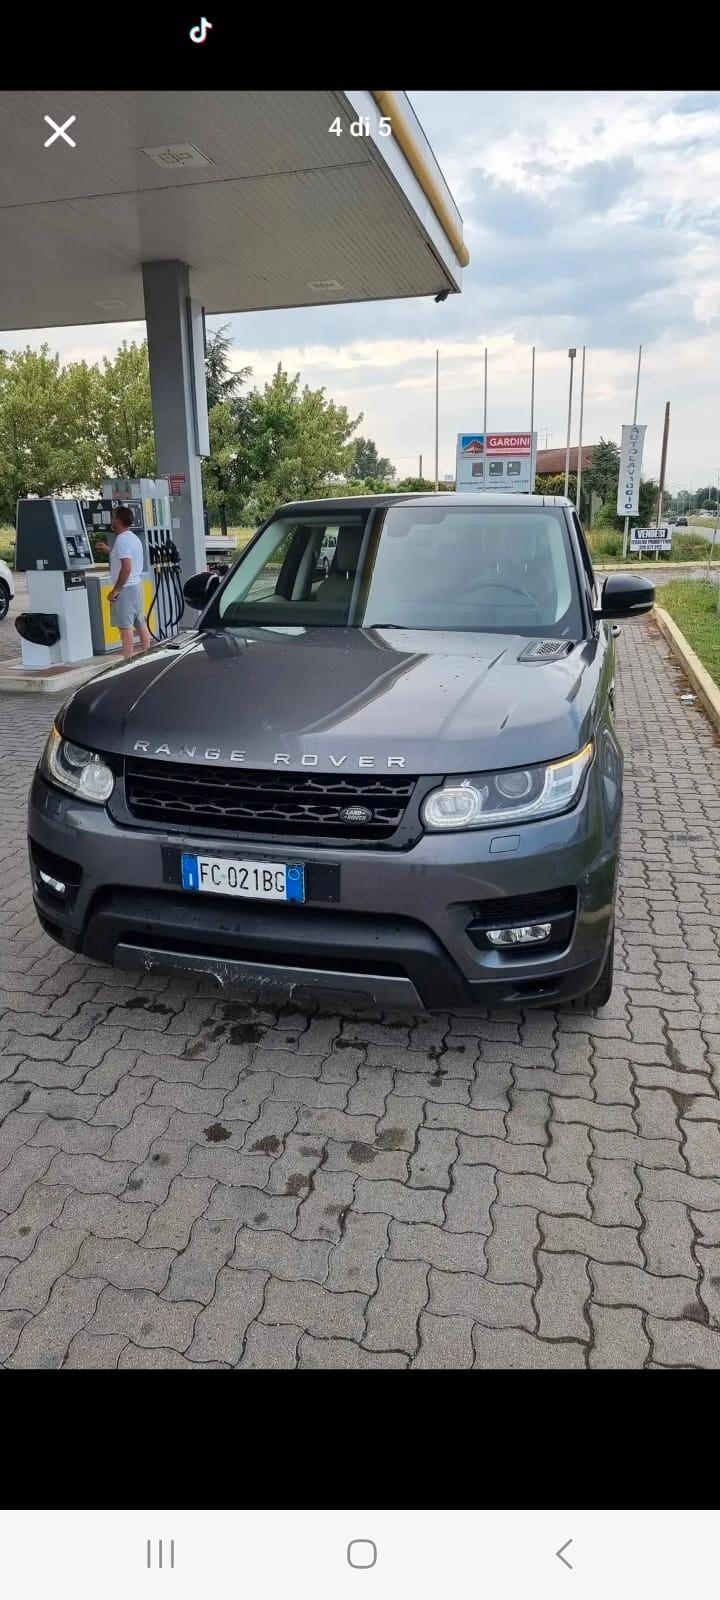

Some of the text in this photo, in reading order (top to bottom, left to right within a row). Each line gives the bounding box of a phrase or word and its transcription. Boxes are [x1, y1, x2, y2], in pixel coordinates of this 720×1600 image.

[489, 437, 530, 447] GARDINI
[624, 426, 640, 509] AUTOLAVAGGIO
[134, 740, 406, 768] RANGE ROVER
